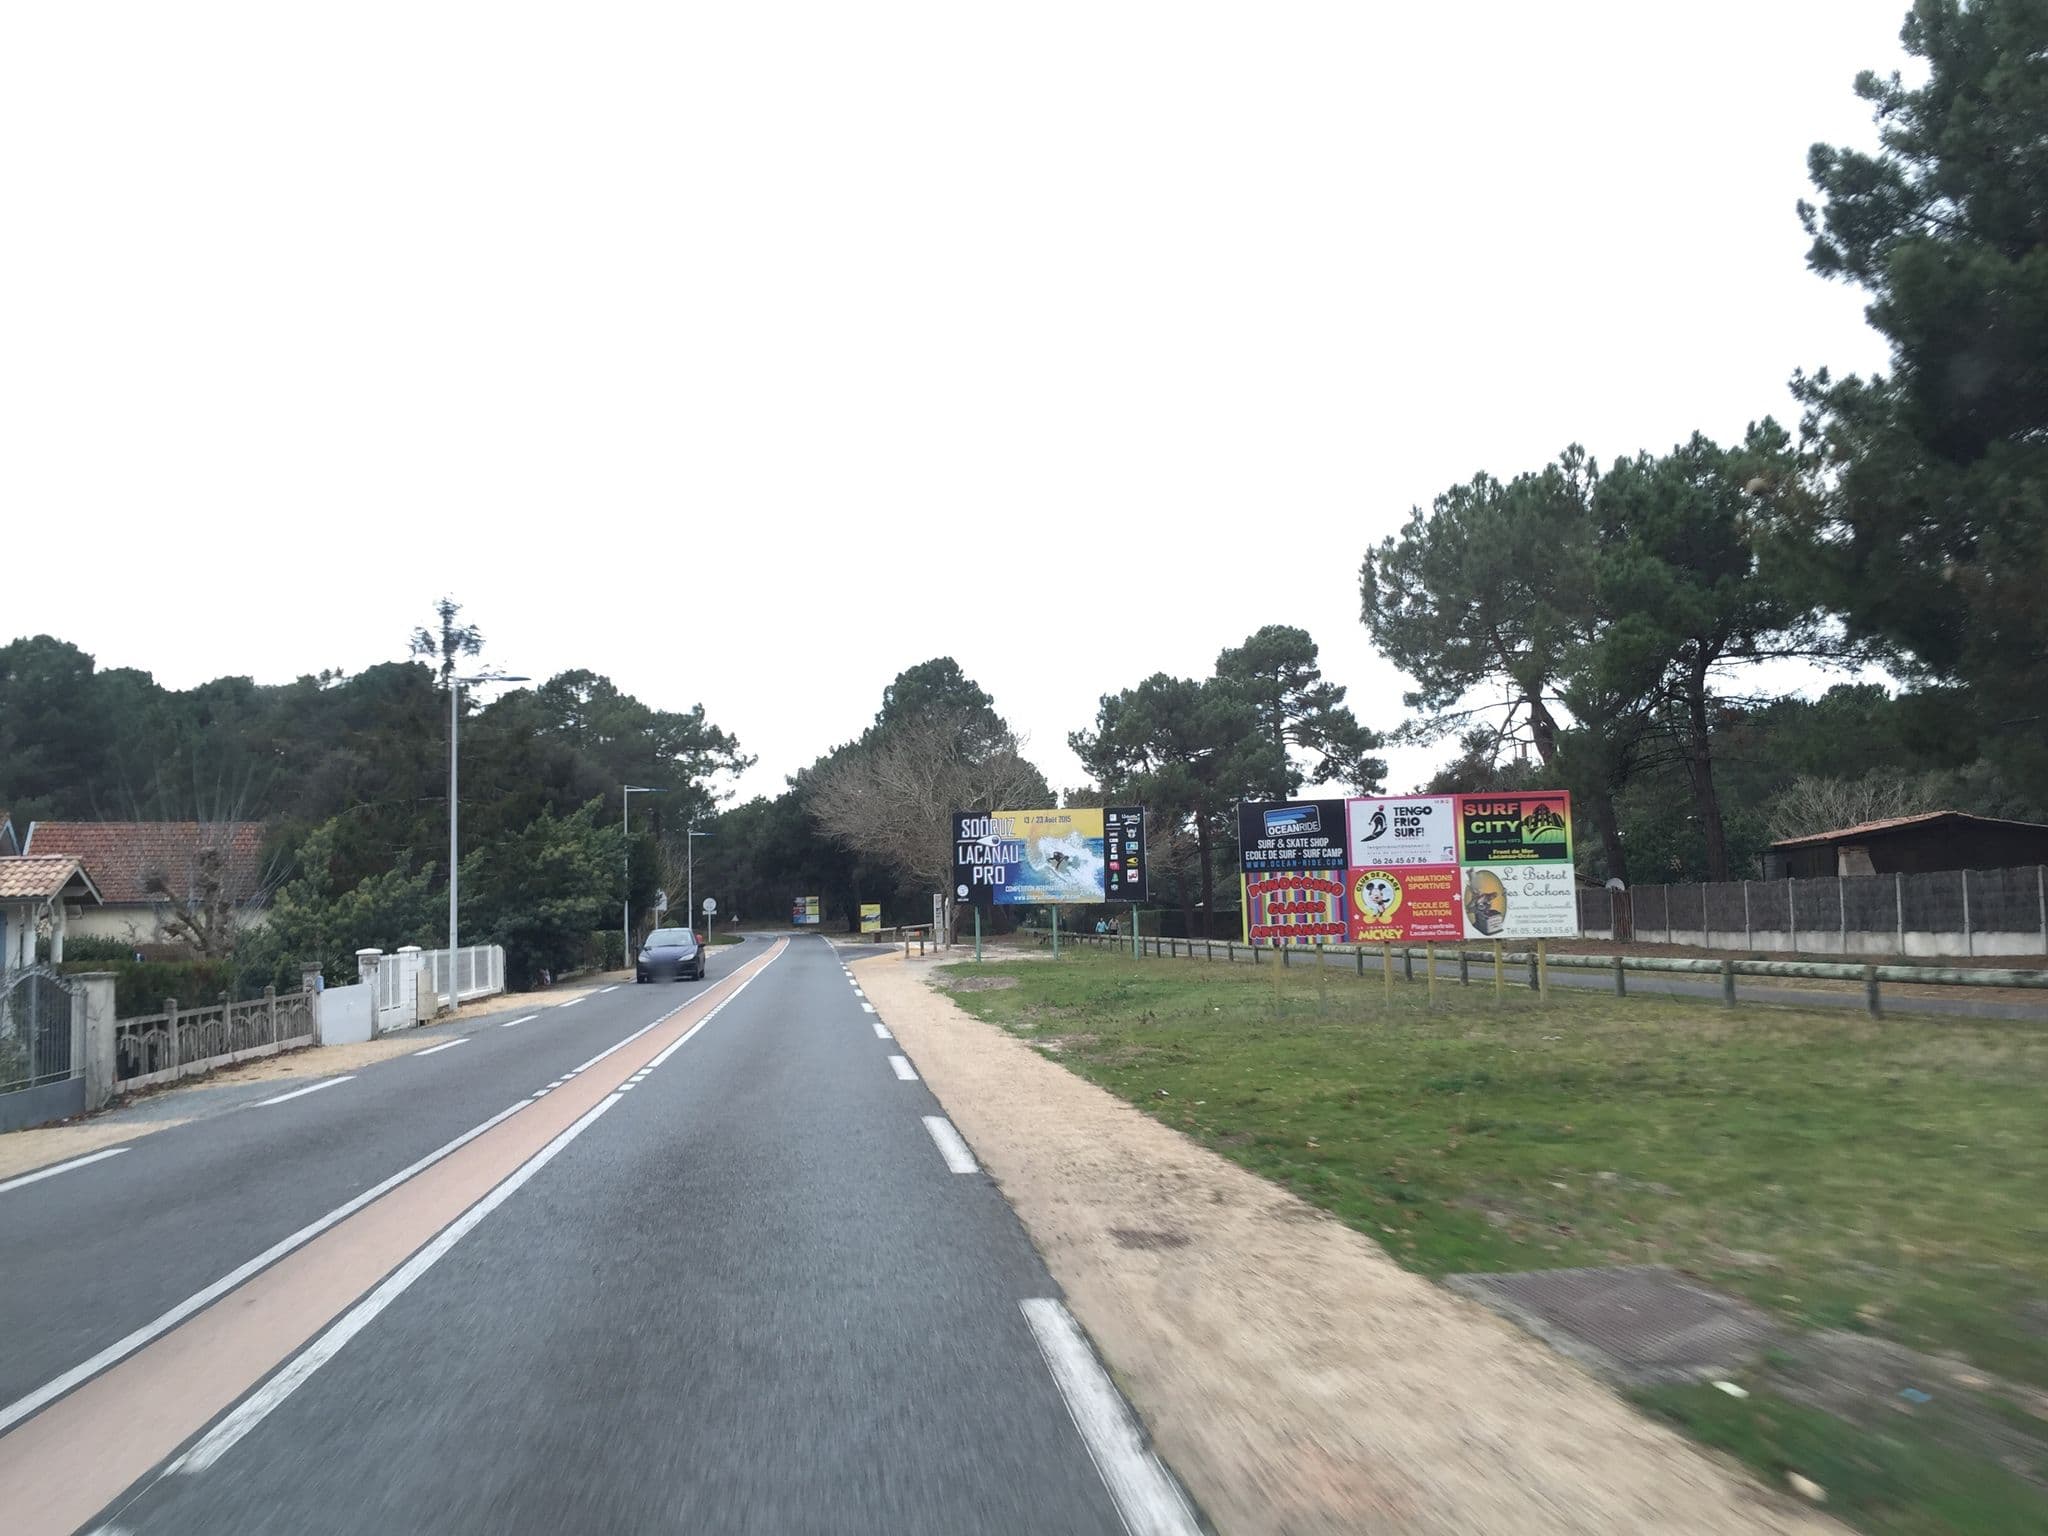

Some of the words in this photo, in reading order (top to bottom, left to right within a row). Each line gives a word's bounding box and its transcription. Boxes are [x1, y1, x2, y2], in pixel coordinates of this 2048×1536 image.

[1393, 806, 1432, 816] TENGO
[1464, 803, 1518, 816] SURF
[1394, 817, 1420, 826] FRIO
[1471, 821, 1520, 833] CITY
[1268, 821, 1318, 835] OCEANRIDE
[1394, 828, 1424, 837] SURF!
[1257, 839, 1275, 849] SURF
[1277, 839, 1285, 848] &
[1286, 838, 1308, 848] SKATE
[1310, 838, 1329, 847] SHOP
[959, 845, 1018, 864] LACANAU
[1245, 851, 1266, 860] ECOLE
[1268, 850, 1277, 860] DE
[1278, 850, 1297, 859] SURF
[1303, 849, 1320, 858] SURF
[1322, 848, 1343, 858] CAMP
[973, 866, 1005, 885] PRO
[1523, 866, 1567, 880] Bistrot
[1356, 876, 1369, 892] CLUB
[1382, 873, 1400, 891] PLAGE
[1523, 882, 1571, 896] Cochons
[1358, 929, 1403, 940] MICKEY
